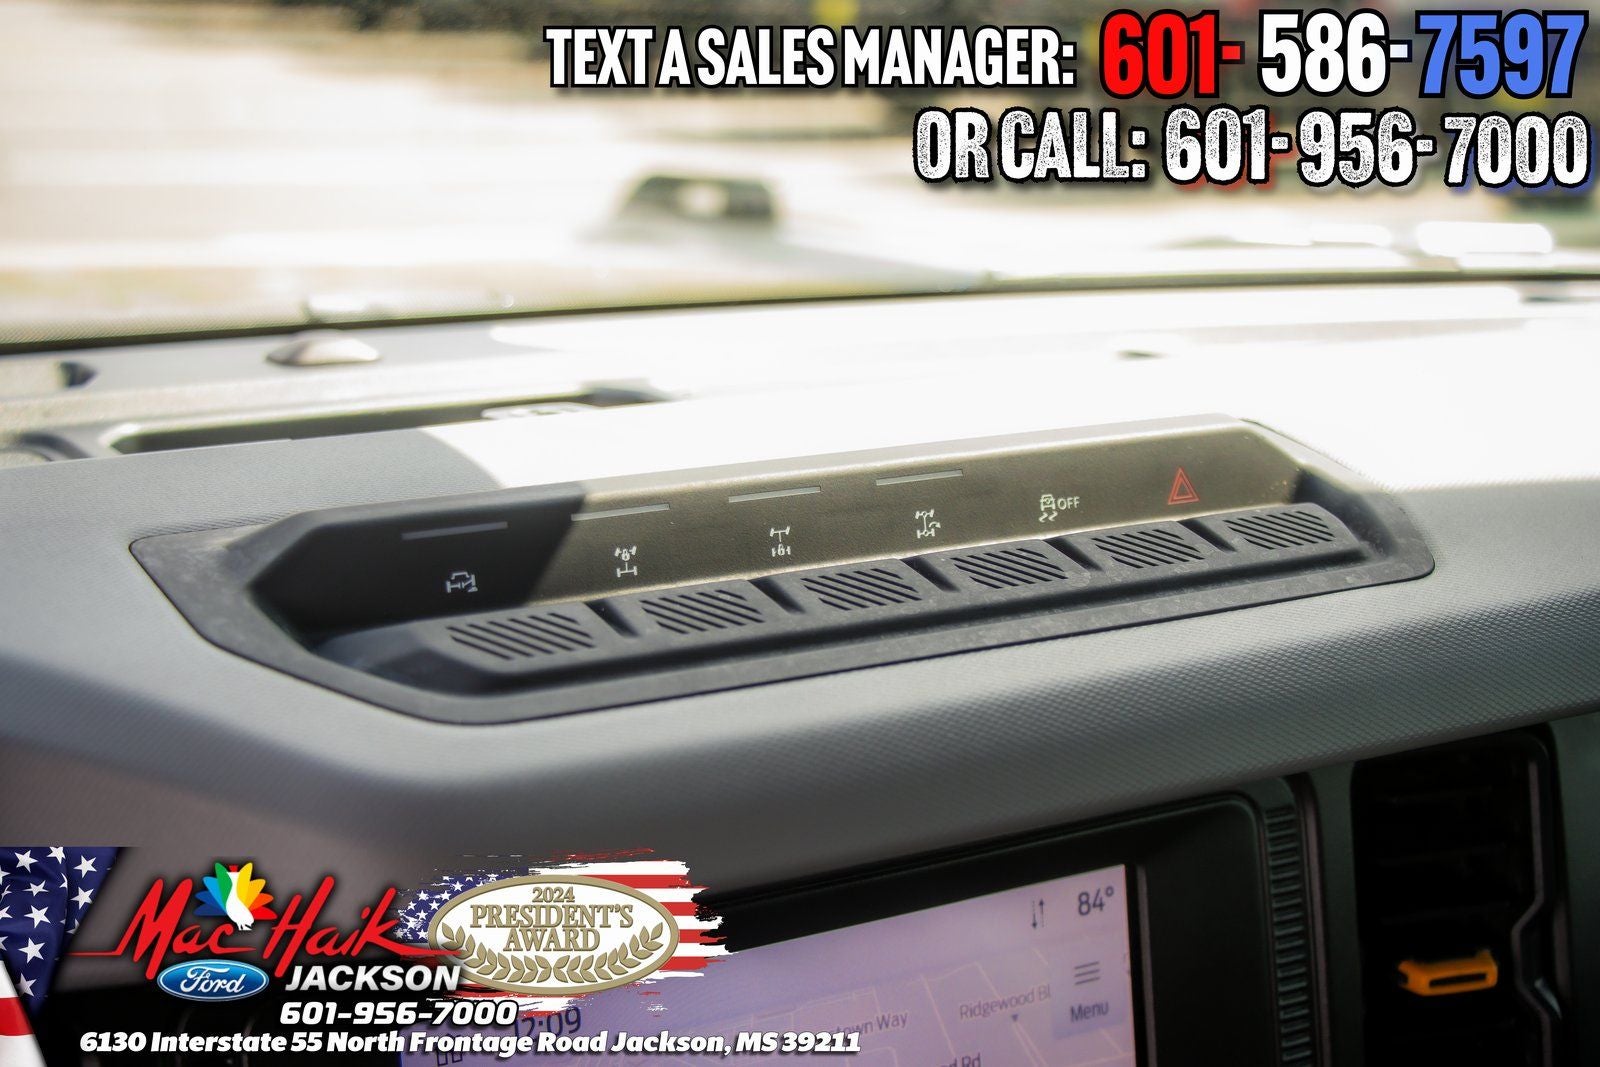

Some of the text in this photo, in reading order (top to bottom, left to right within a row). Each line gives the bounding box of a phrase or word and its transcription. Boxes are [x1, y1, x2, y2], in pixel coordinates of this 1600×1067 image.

[1057, 496, 1080, 510] OFF
[959, 989, 1036, 1021] Ridgewood
[1070, 1001, 1110, 1023] Menu
[876, 1012, 908, 1031] Way
